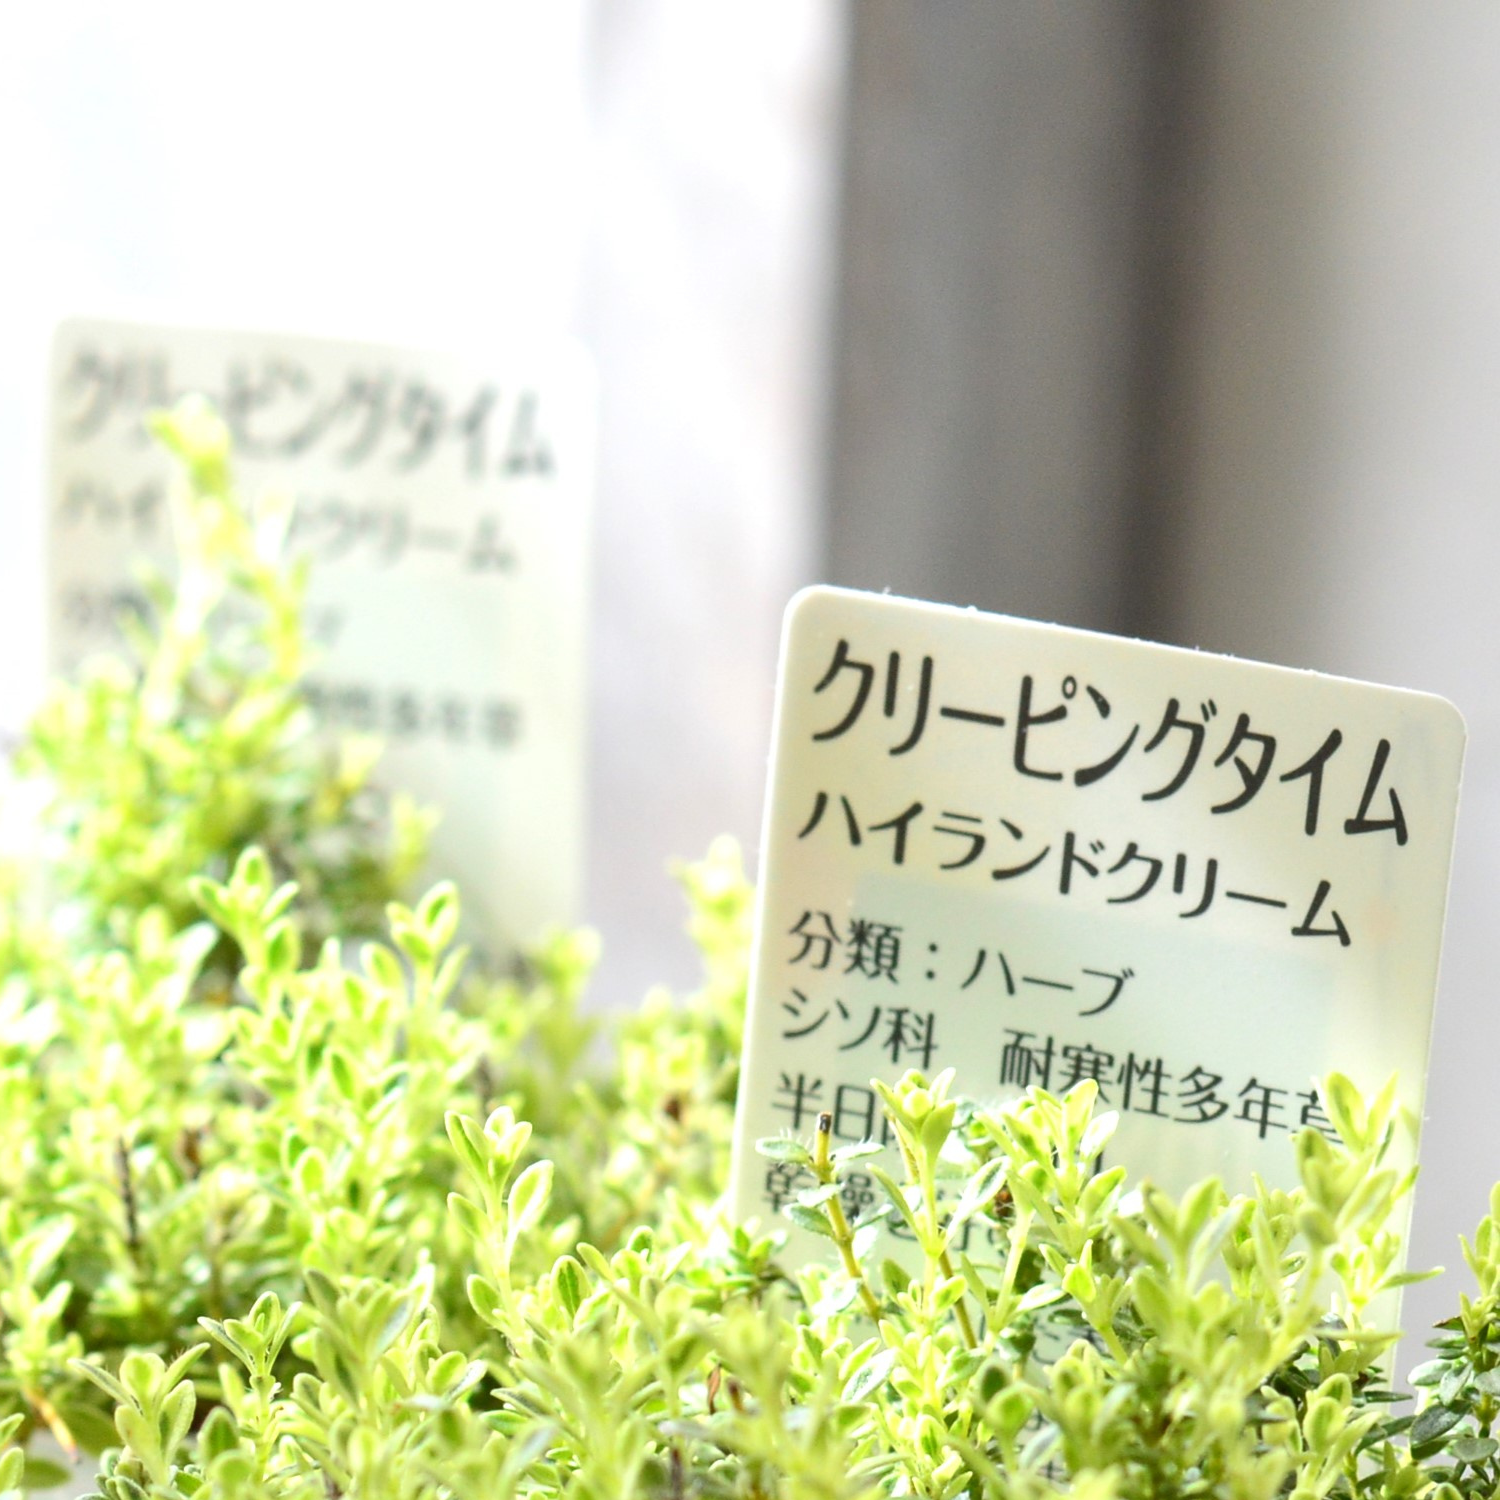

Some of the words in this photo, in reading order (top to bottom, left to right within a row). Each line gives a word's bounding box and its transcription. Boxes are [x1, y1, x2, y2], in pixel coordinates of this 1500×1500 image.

[65, 346, 556, 480] クリピングタイム
[812, 639, 1409, 846] クリーピングタイム
[798, 791, 1352, 947] ハイランドクリーム
[781, 987, 939, 1072] シソ科
[787, 909, 1135, 1017] 分類：ハーブ
